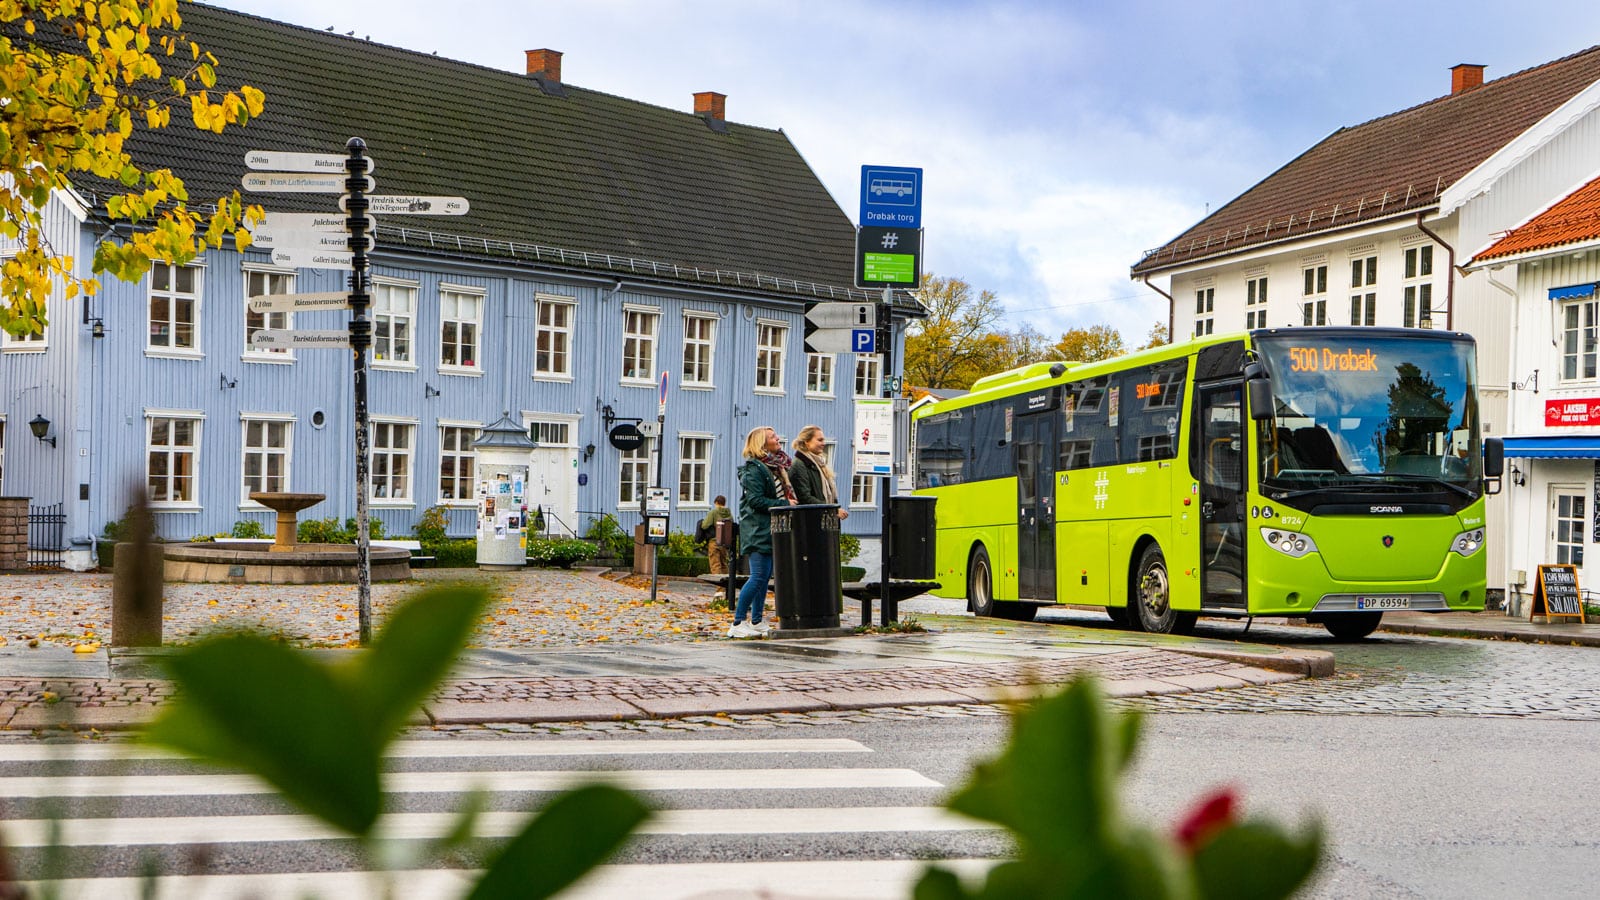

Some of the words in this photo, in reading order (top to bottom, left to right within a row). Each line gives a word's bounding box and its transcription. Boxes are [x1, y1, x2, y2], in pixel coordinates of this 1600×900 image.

[250, 156, 269, 164] 200m
[314, 159, 344, 168] Båthavna
[248, 178, 266, 186] 200m
[371, 196, 394, 204] Fredrik
[396, 197, 415, 205] Stabel
[867, 211, 896, 220] Drøbak
[897, 213, 914, 223] torg
[312, 218, 344, 228] Julehuset
[255, 234, 273, 243] 200m
[319, 237, 346, 246] Akvariet
[275, 253, 291, 261] 200m
[312, 256, 330, 265] Galleri
[294, 298, 346, 306] Båtmotormuseet
[292, 335, 348, 344] Turistinformasjon
[857, 333, 871, 350] P
[1289, 348, 1318, 372] 500
[1322, 348, 1378, 372] Drøbak
[1563, 404, 1587, 414] LAKSEN
[1281, 516, 1302, 526] 8724
[1364, 598, 1377, 608] DP
[1380, 598, 1408, 608] 69594
